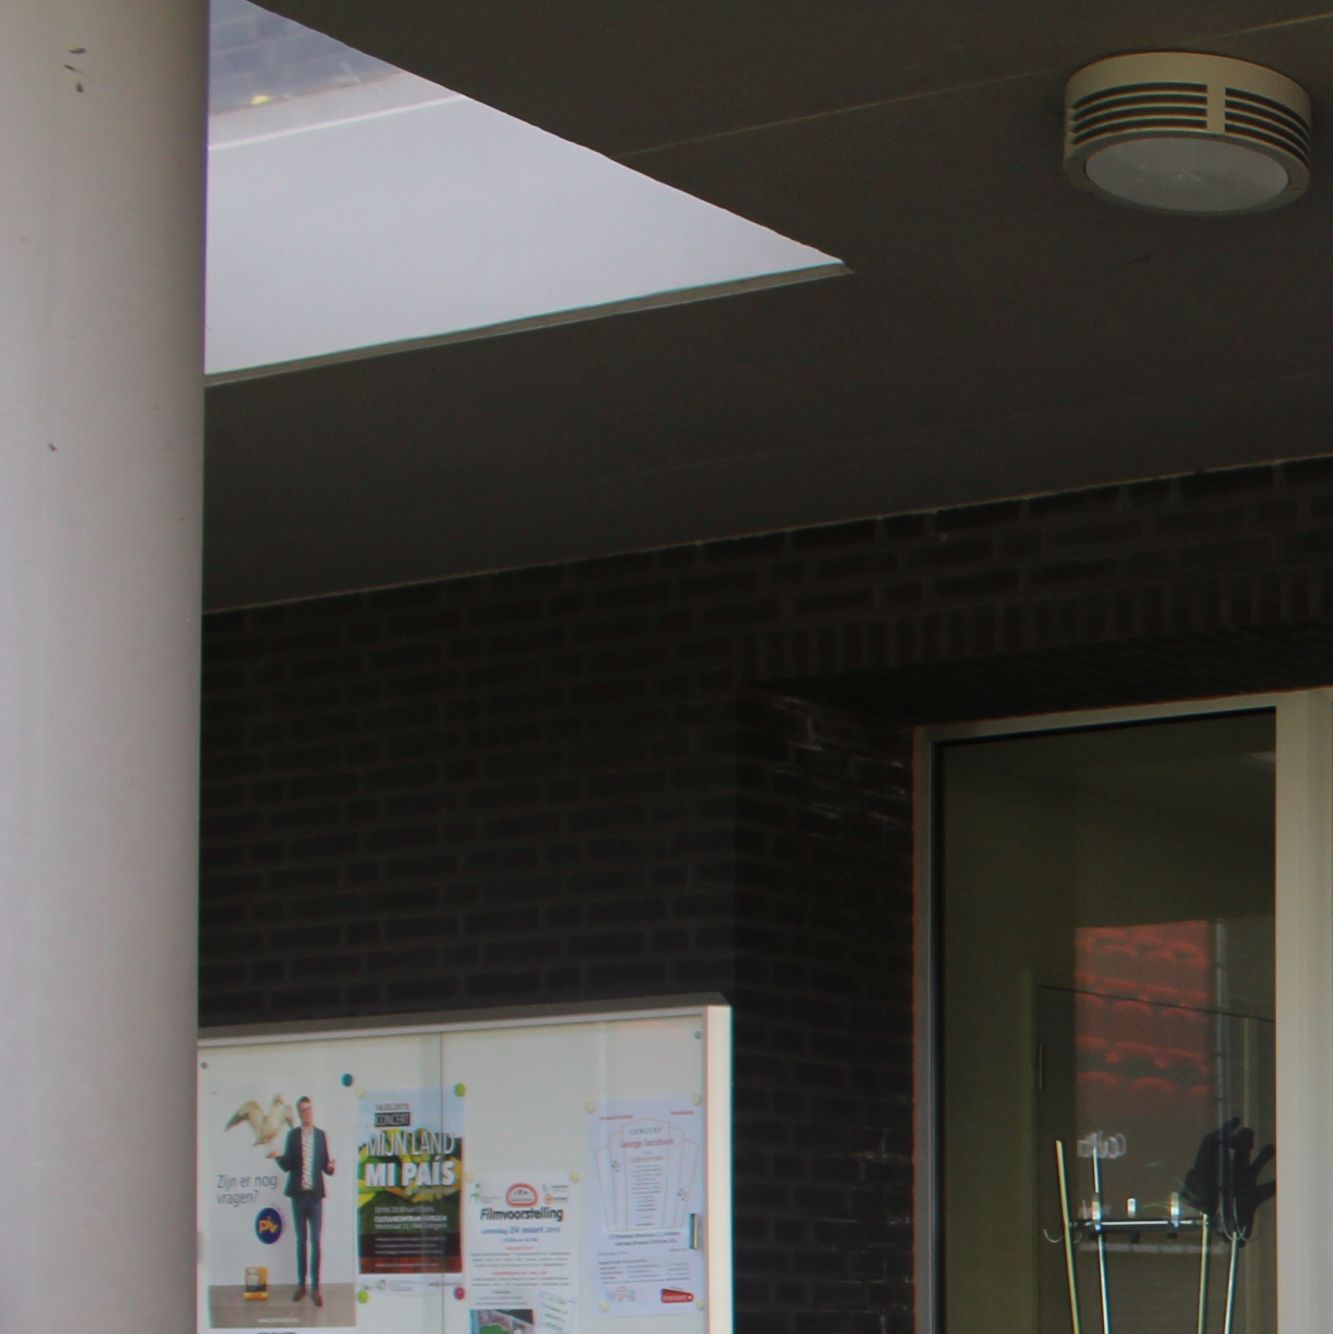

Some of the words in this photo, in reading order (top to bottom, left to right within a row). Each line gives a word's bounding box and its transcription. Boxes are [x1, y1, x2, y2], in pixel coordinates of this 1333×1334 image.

[366, 1132, 409, 1157] MIJN
[411, 1130, 455, 1156] LAND
[364, 1162, 396, 1187] MI
[401, 1154, 456, 1187] PAÍS
[216, 1174, 237, 1191] Zijn
[240, 1176, 252, 1188] er
[254, 1175, 278, 1189] nog
[216, 1190, 259, 1207] vragen?
[480, 1206, 564, 1223] Filmvoorstelling
